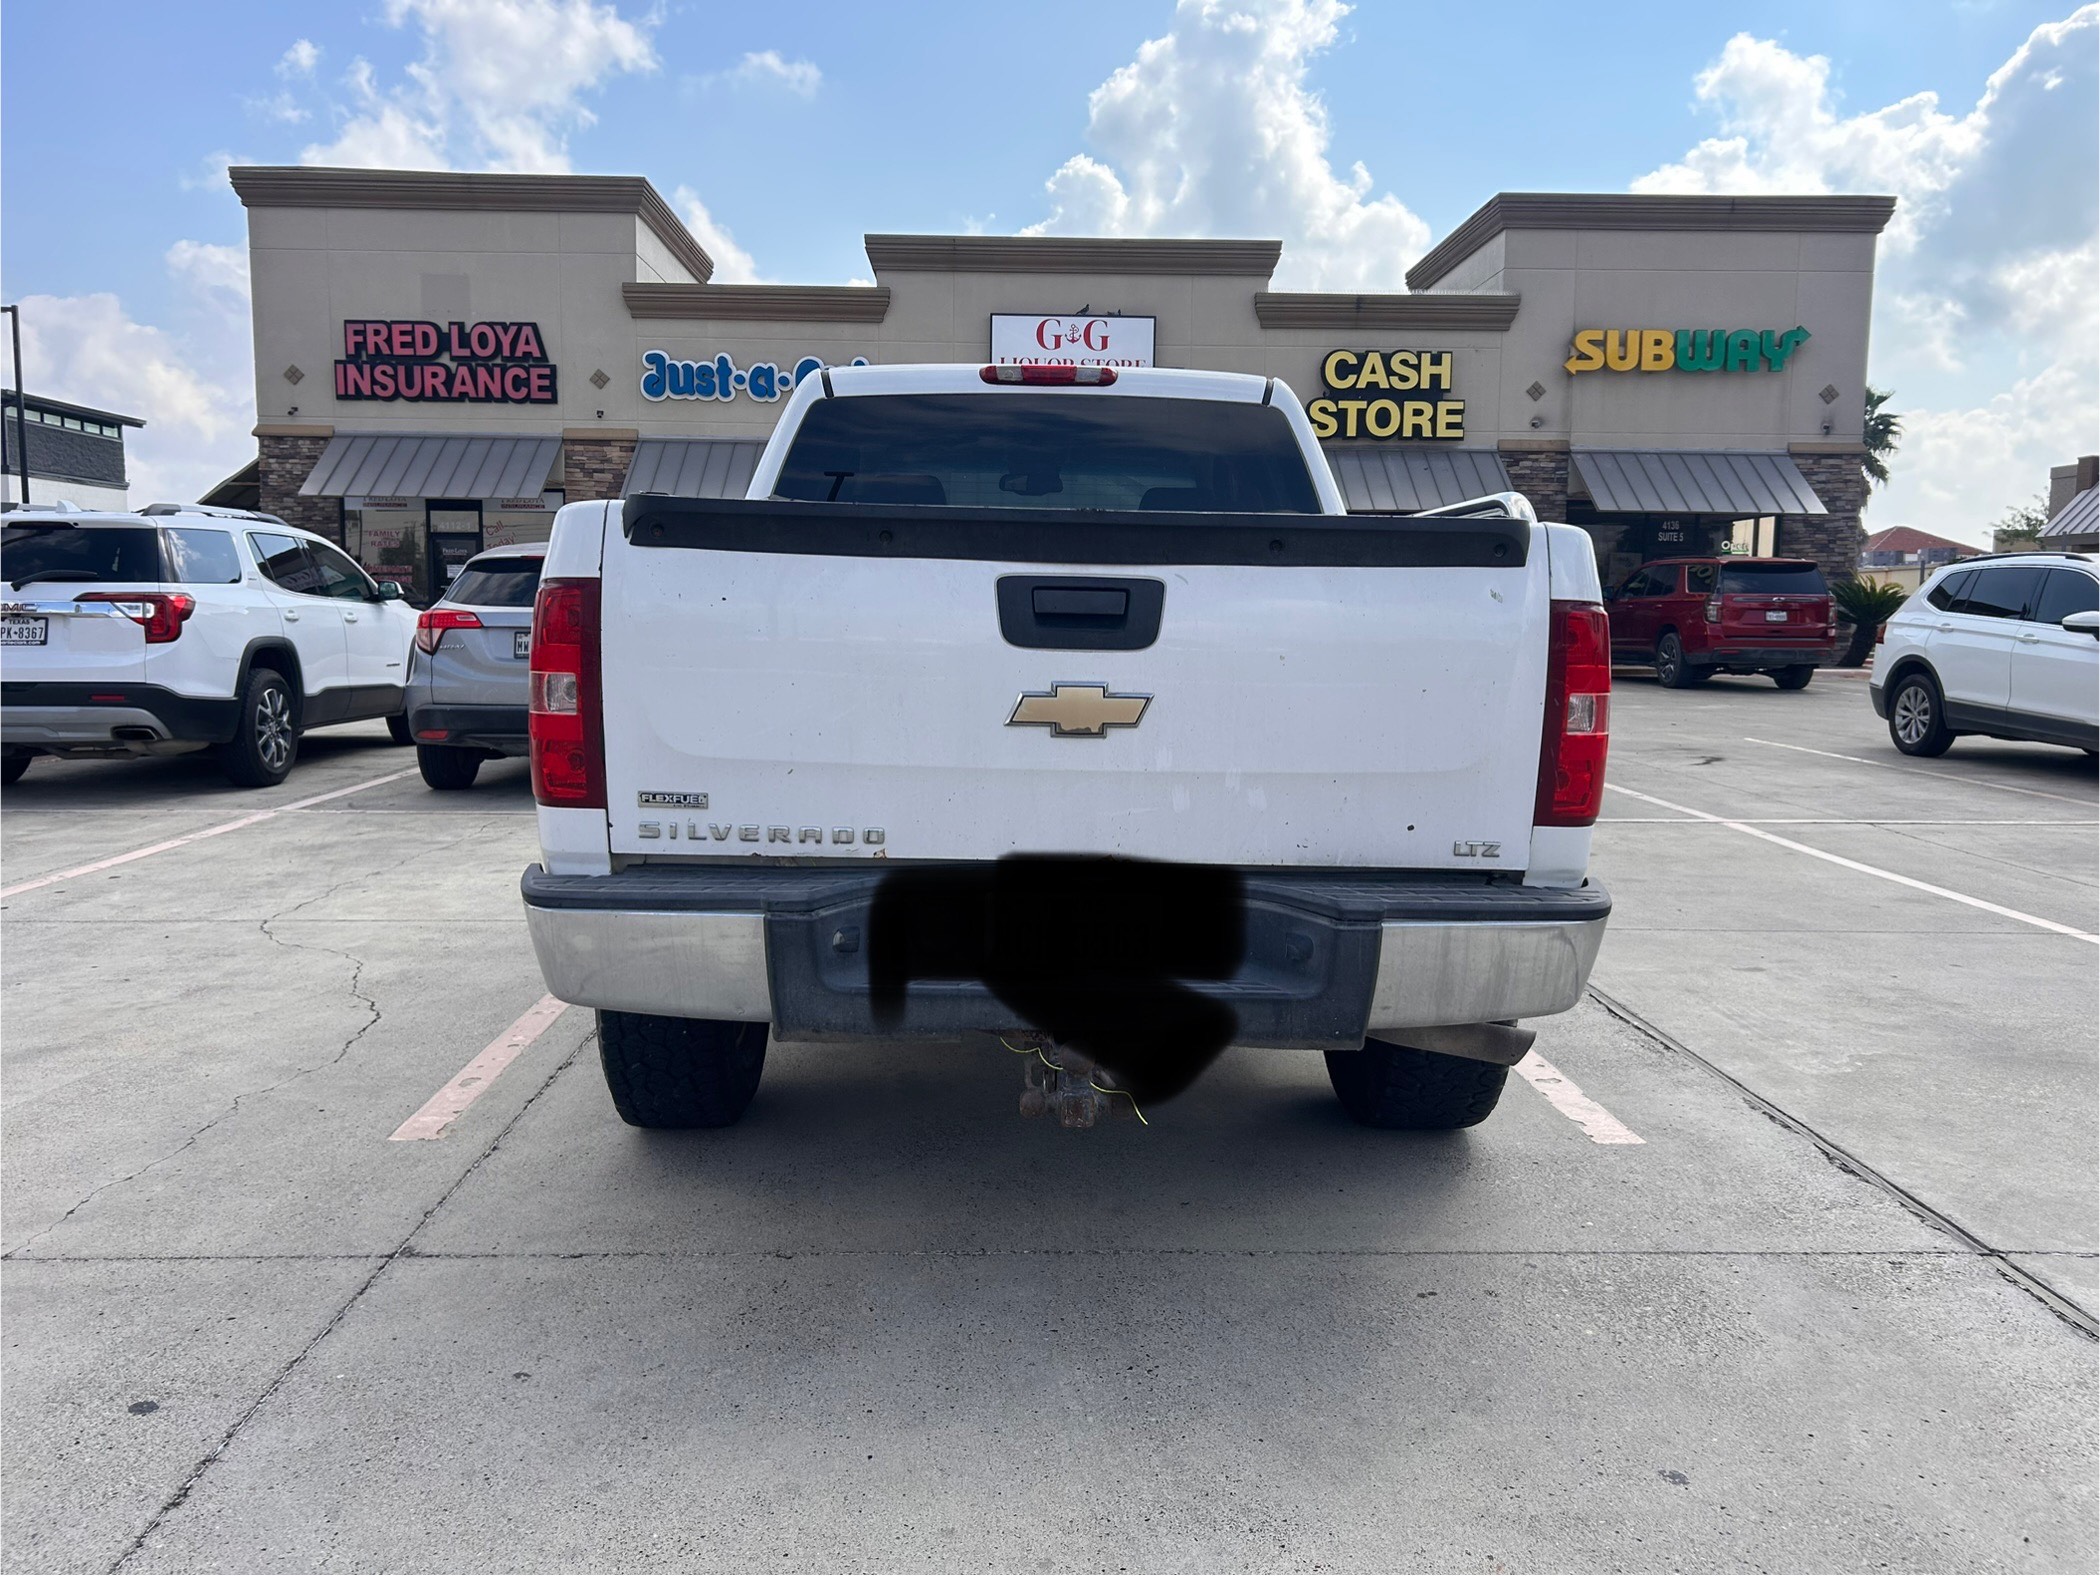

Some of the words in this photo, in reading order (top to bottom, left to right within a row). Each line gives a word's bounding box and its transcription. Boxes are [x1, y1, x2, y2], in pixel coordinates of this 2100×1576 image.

[345, 323, 439, 357] FRED
[450, 324, 542, 359] LOYA
[1563, 325, 1812, 376] SUBWAY
[335, 363, 553, 400] INSURANCE
[1324, 350, 1452, 390] CASH
[1309, 399, 1464, 438] STORE
[368, 530, 400, 538] FAMILY
[486, 520, 505, 536] Call
[1658, 532, 1678, 542] SUITE
[638, 820, 885, 845] SILVERADO
[1453, 840, 1501, 858] LTZ
